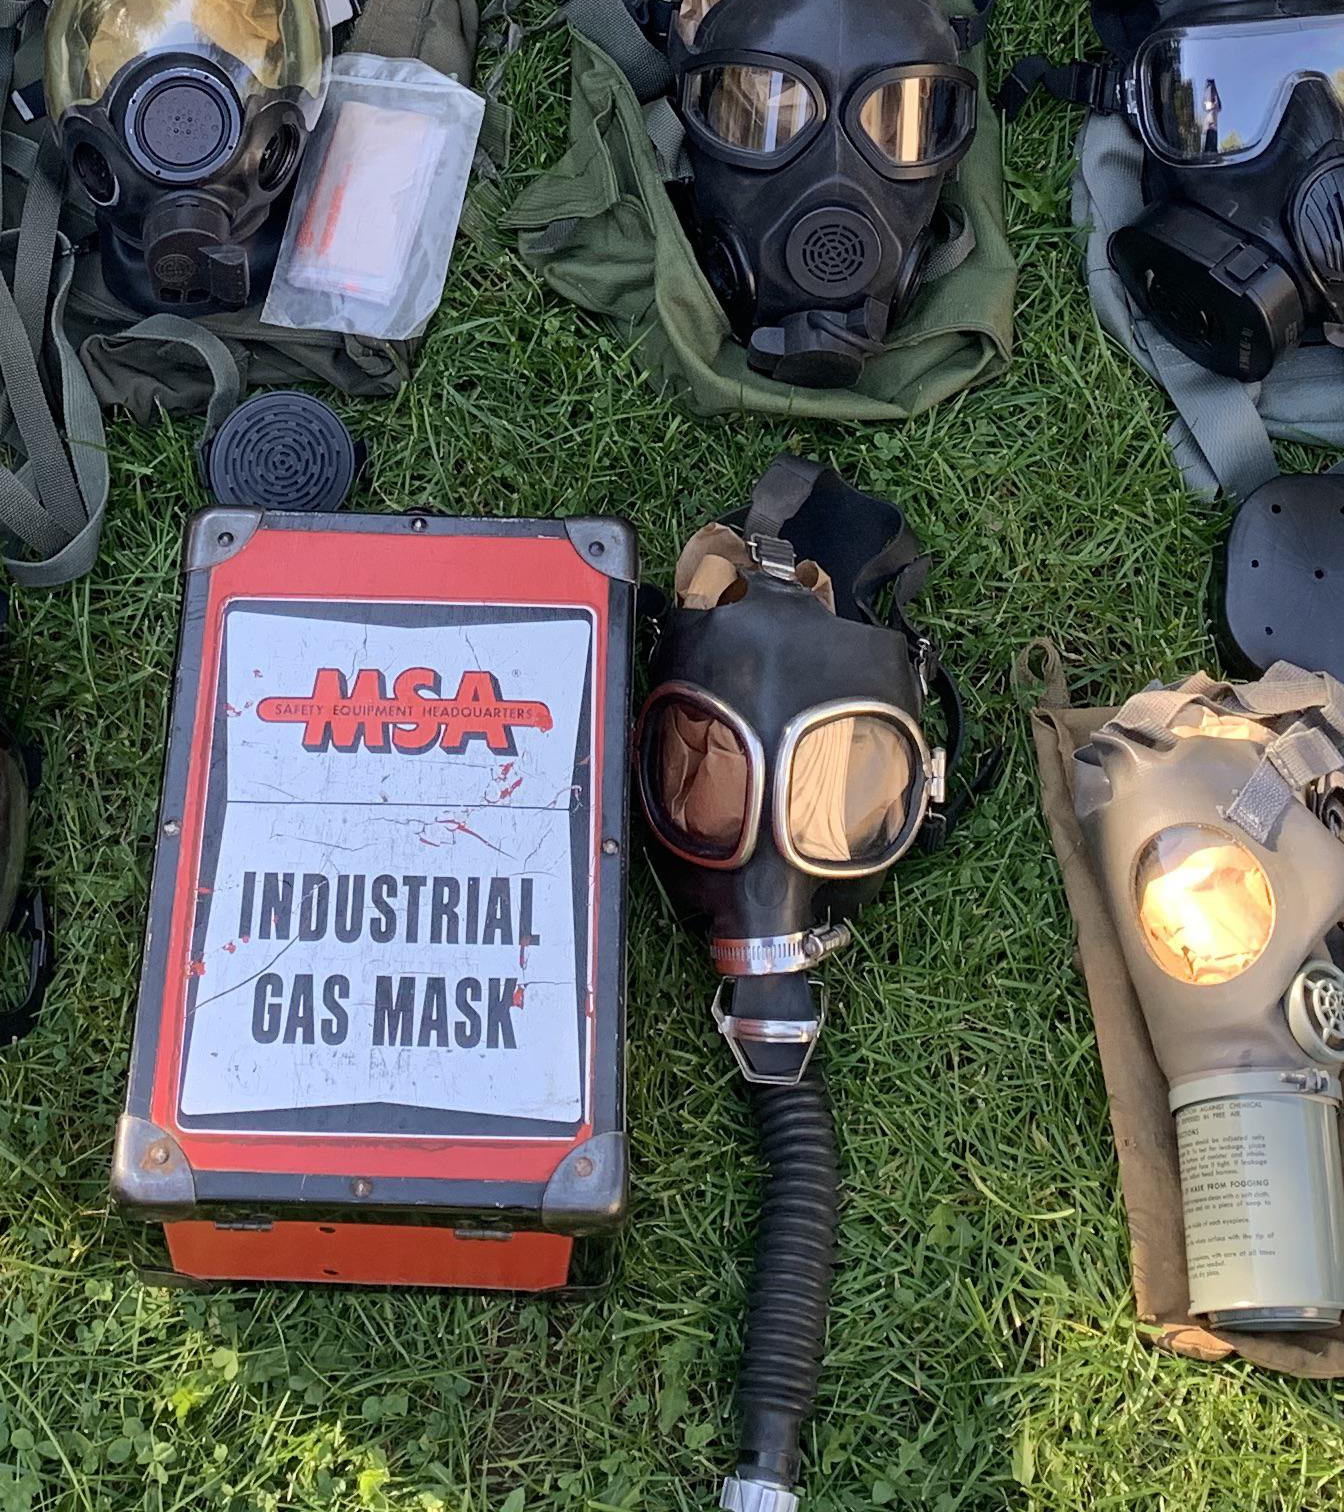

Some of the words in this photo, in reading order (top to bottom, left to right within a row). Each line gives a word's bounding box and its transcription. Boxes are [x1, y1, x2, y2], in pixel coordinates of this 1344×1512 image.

[275, 702, 324, 716] SAFETY
[333, 704, 414, 718] EQUIPMENT
[422, 704, 533, 720] HEADQUARTERS
[302, 667, 518, 756] MSA
[238, 872, 540, 946] INDUSTRIAL
[252, 972, 350, 1046] GAS
[372, 975, 518, 1049] MASK
[1199, 1103, 1226, 1113] AGAINST
[1228, 1101, 1264, 1110] CHEMICAL
[1212, 1111, 1226, 1119] FREE
[1230, 1150, 1243, 1158] and
[1241, 1158, 1268, 1168] leakage
[1207, 1180, 1227, 1191] FROM
[1230, 1179, 1270, 1188] FOGGING
